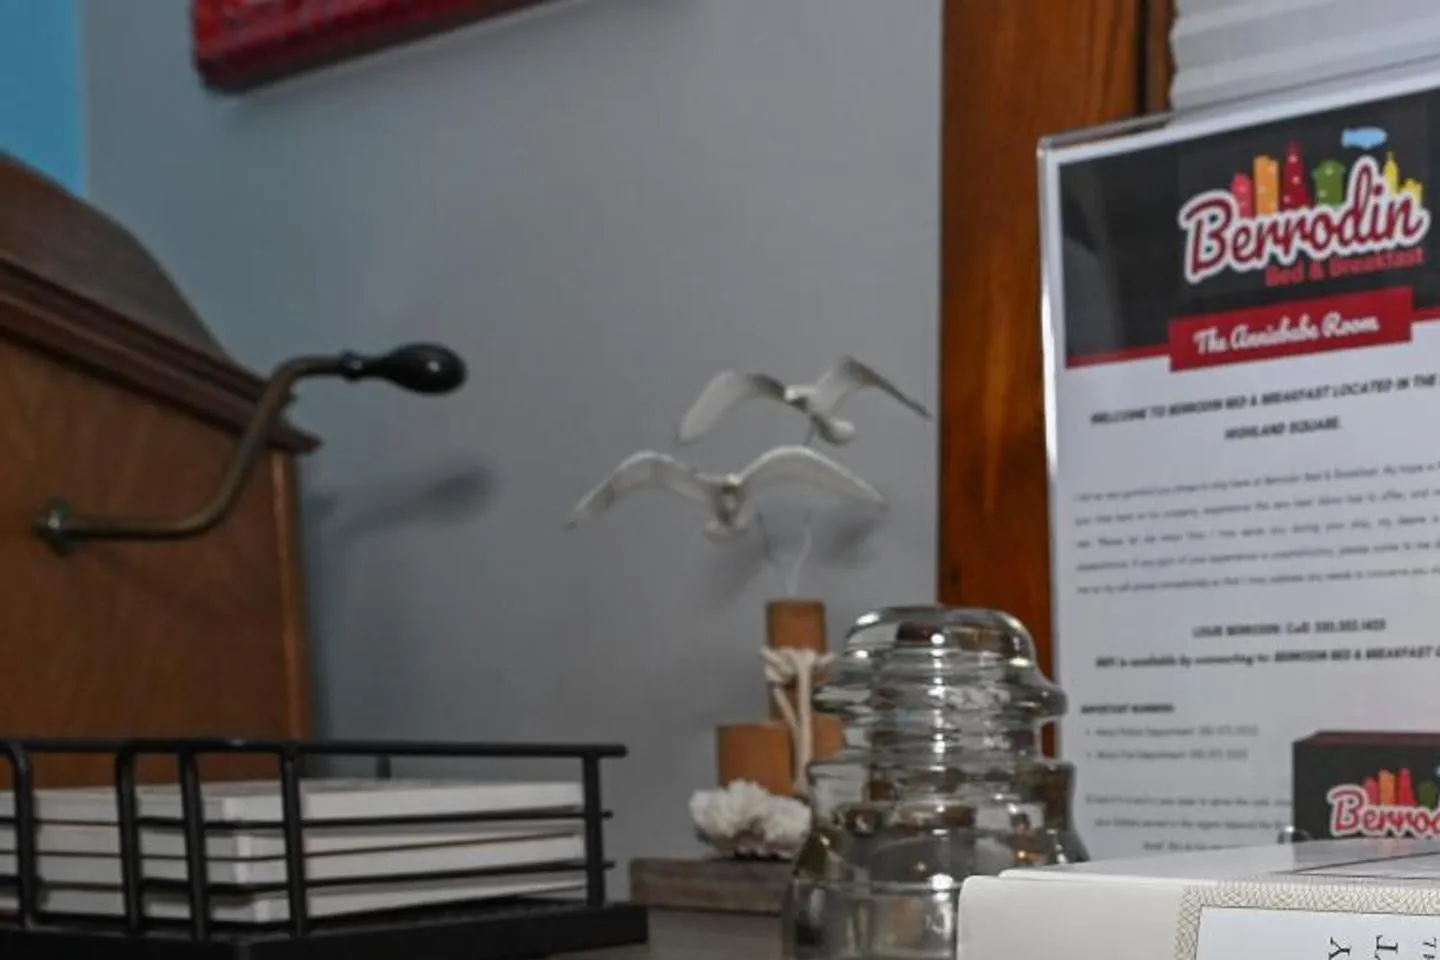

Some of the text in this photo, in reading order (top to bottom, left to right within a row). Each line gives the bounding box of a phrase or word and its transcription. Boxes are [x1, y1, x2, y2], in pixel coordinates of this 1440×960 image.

[1180, 156, 1431, 282] Berrodin
[1194, 327, 1227, 354] The
[1322, 311, 1380, 338] Room
[1151, 405, 1165, 419] TO
[1332, 377, 1393, 398] LOCATED
[1397, 377, 1410, 391] IN
[1413, 373, 1437, 388] THE
